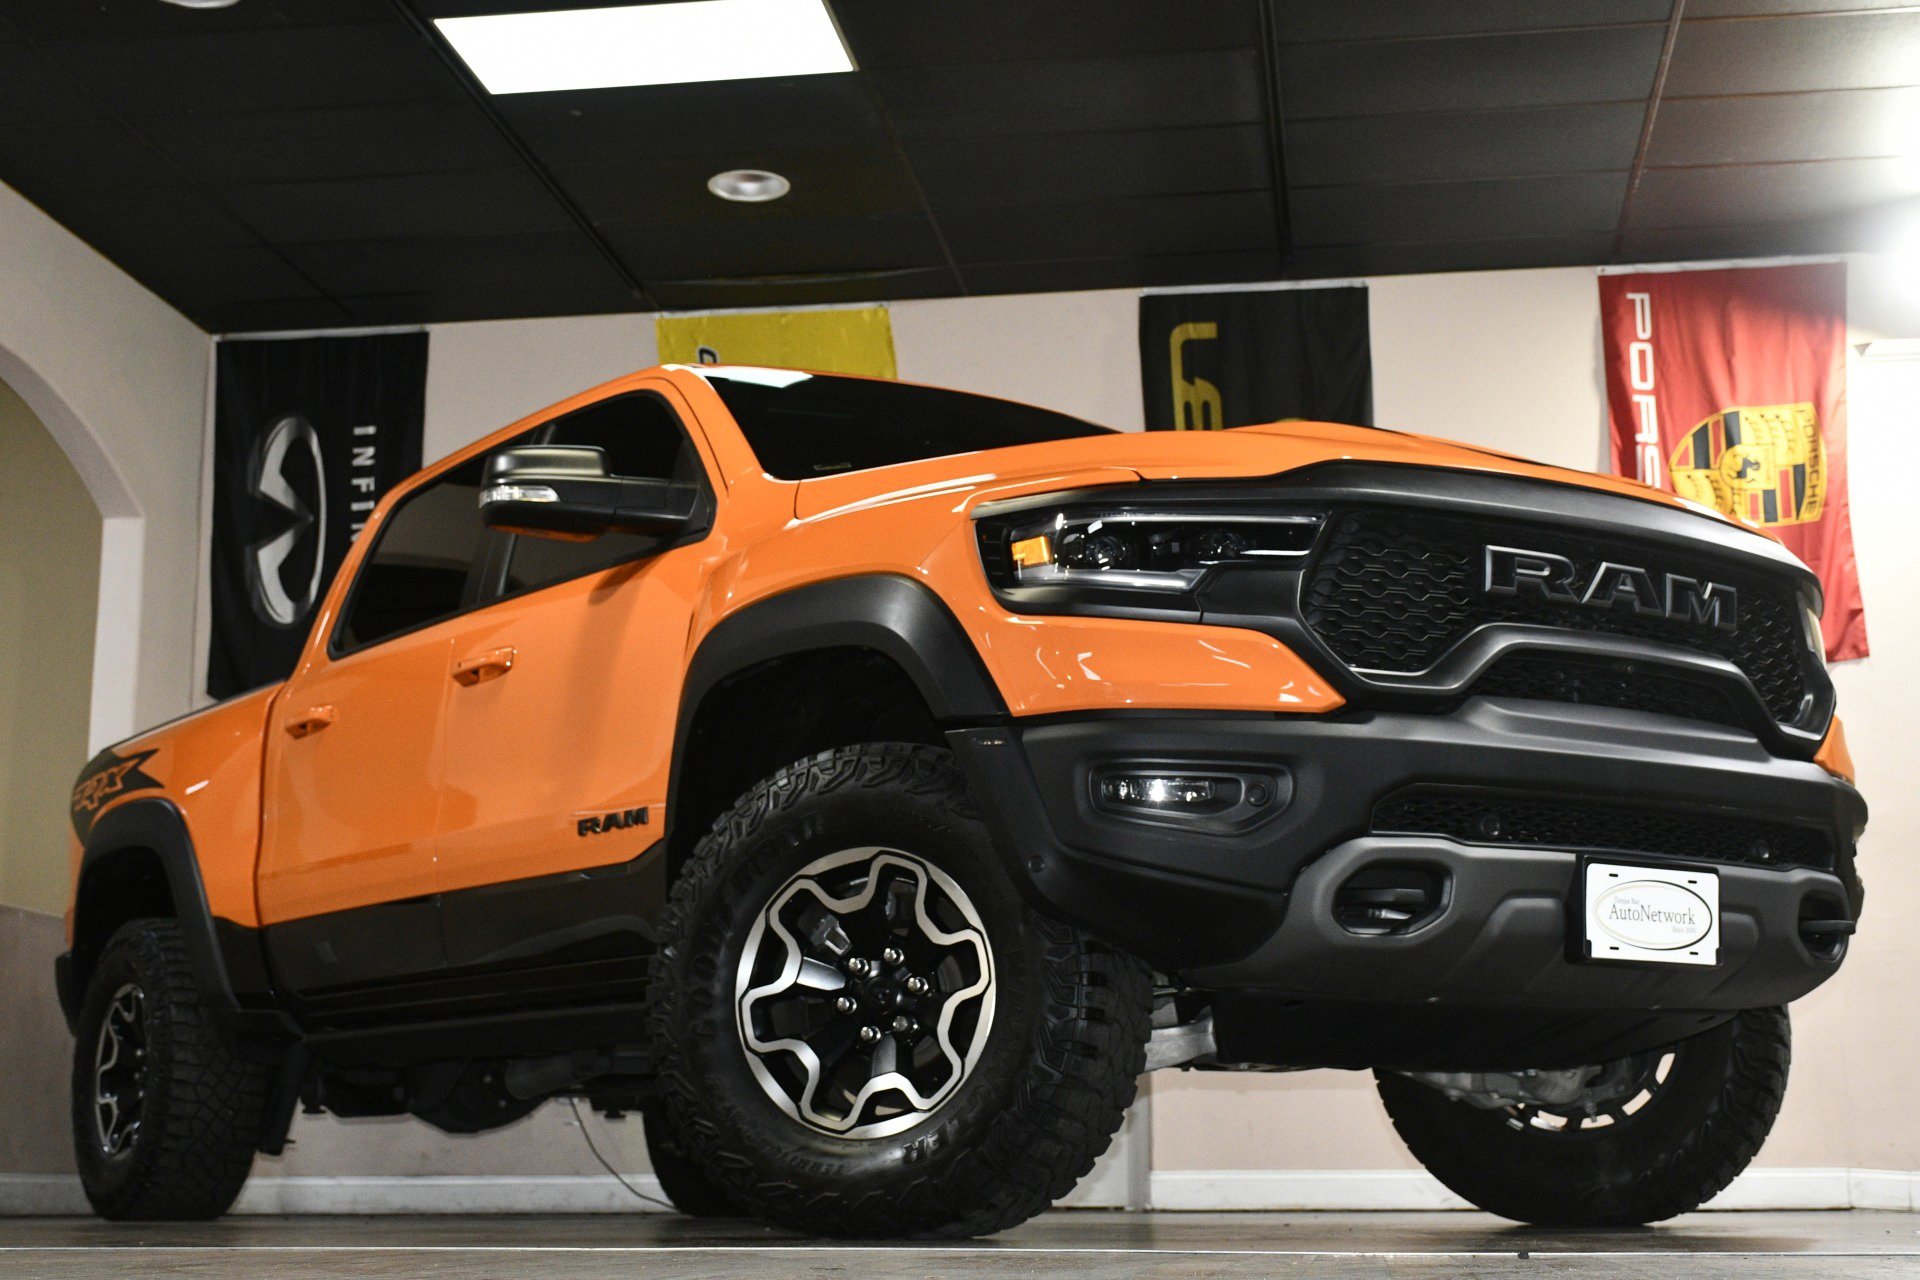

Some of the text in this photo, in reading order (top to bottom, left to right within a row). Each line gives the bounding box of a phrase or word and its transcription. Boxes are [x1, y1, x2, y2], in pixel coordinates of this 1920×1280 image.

[1484, 544, 1739, 632] RAM
[577, 806, 649, 837] RAM
[1610, 905, 1695, 925] AutoNetwork
